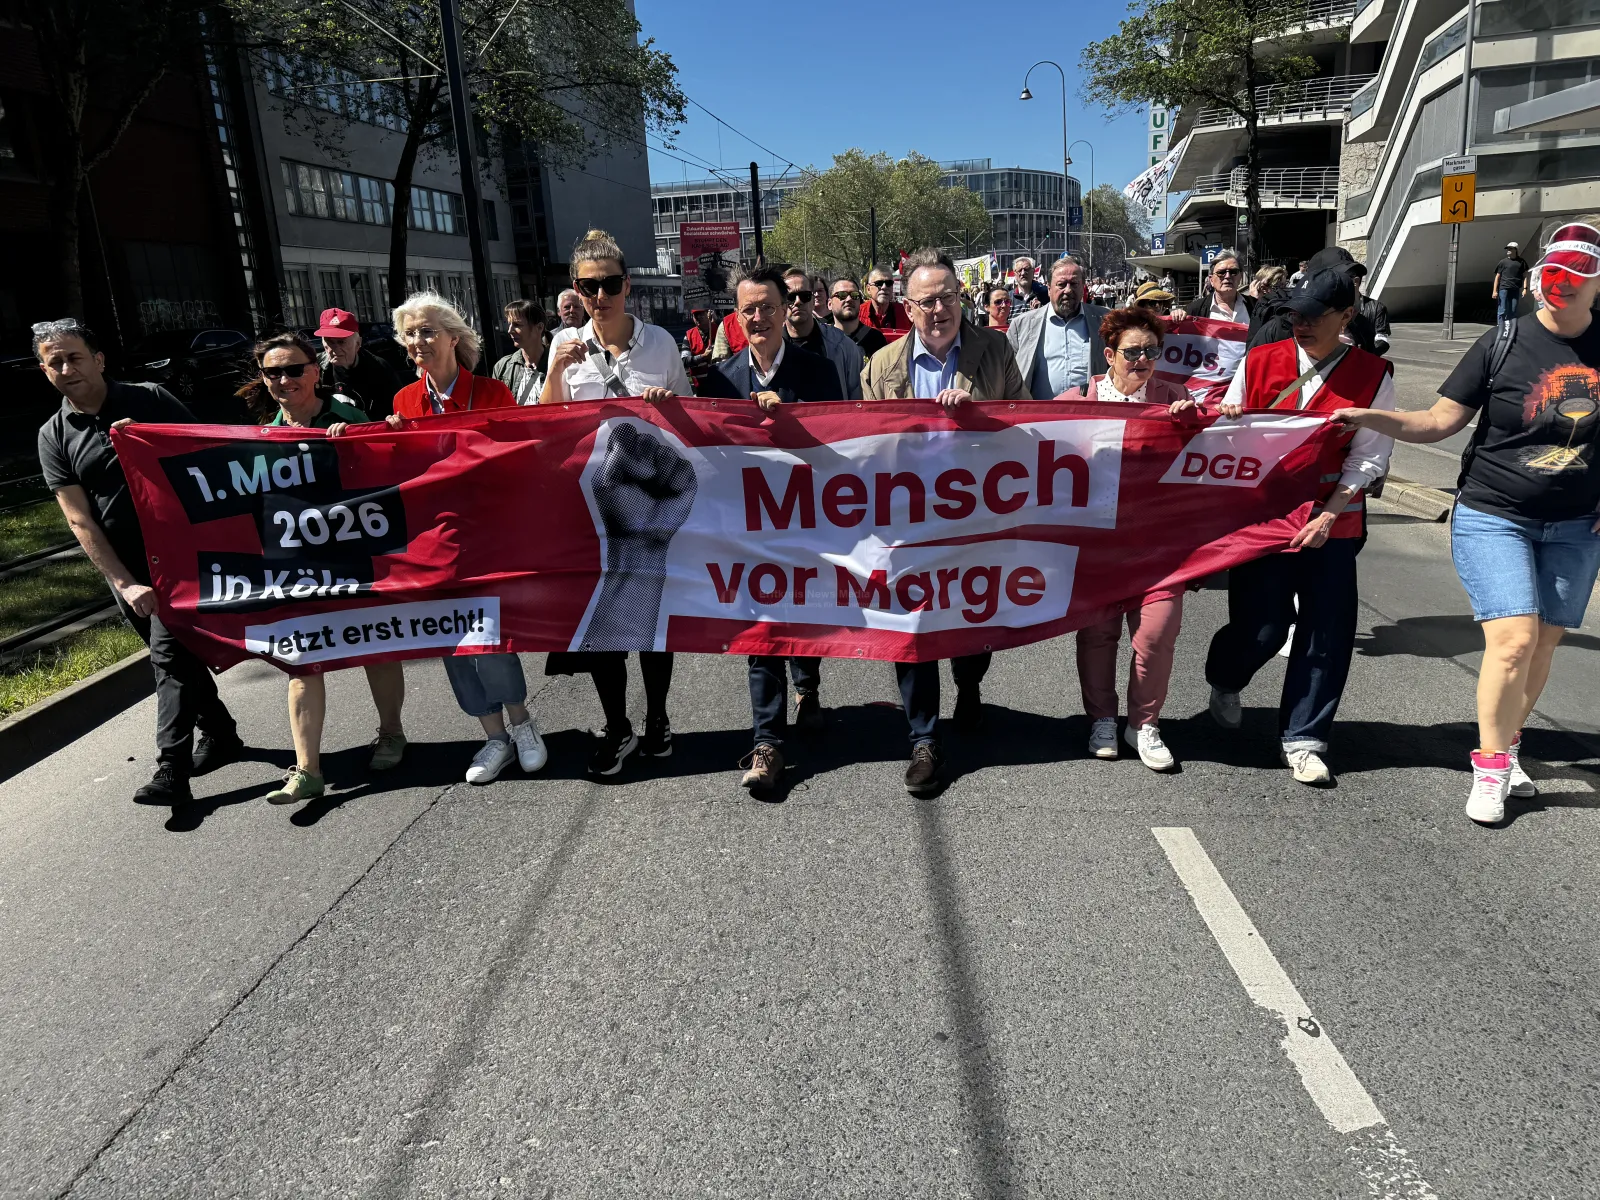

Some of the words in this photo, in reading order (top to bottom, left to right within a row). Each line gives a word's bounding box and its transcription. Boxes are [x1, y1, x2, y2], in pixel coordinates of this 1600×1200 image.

[1454, 182, 1463, 192] U
[1160, 342, 1227, 376] obs,
[186, 466, 228, 503] 1.
[228, 443, 316, 496] Mai
[741, 439, 1091, 532] Mensch
[1181, 452, 1263, 481] DGB
[273, 502, 390, 549] 2026
[210, 563, 253, 602] in
[259, 567, 360, 601] Köln
[705, 560, 818, 605] vor
[834, 563, 1047, 624] Marge
[260, 625, 337, 659] Jetzt
[342, 615, 404, 647] erst
[409, 608, 486, 640] recht!
